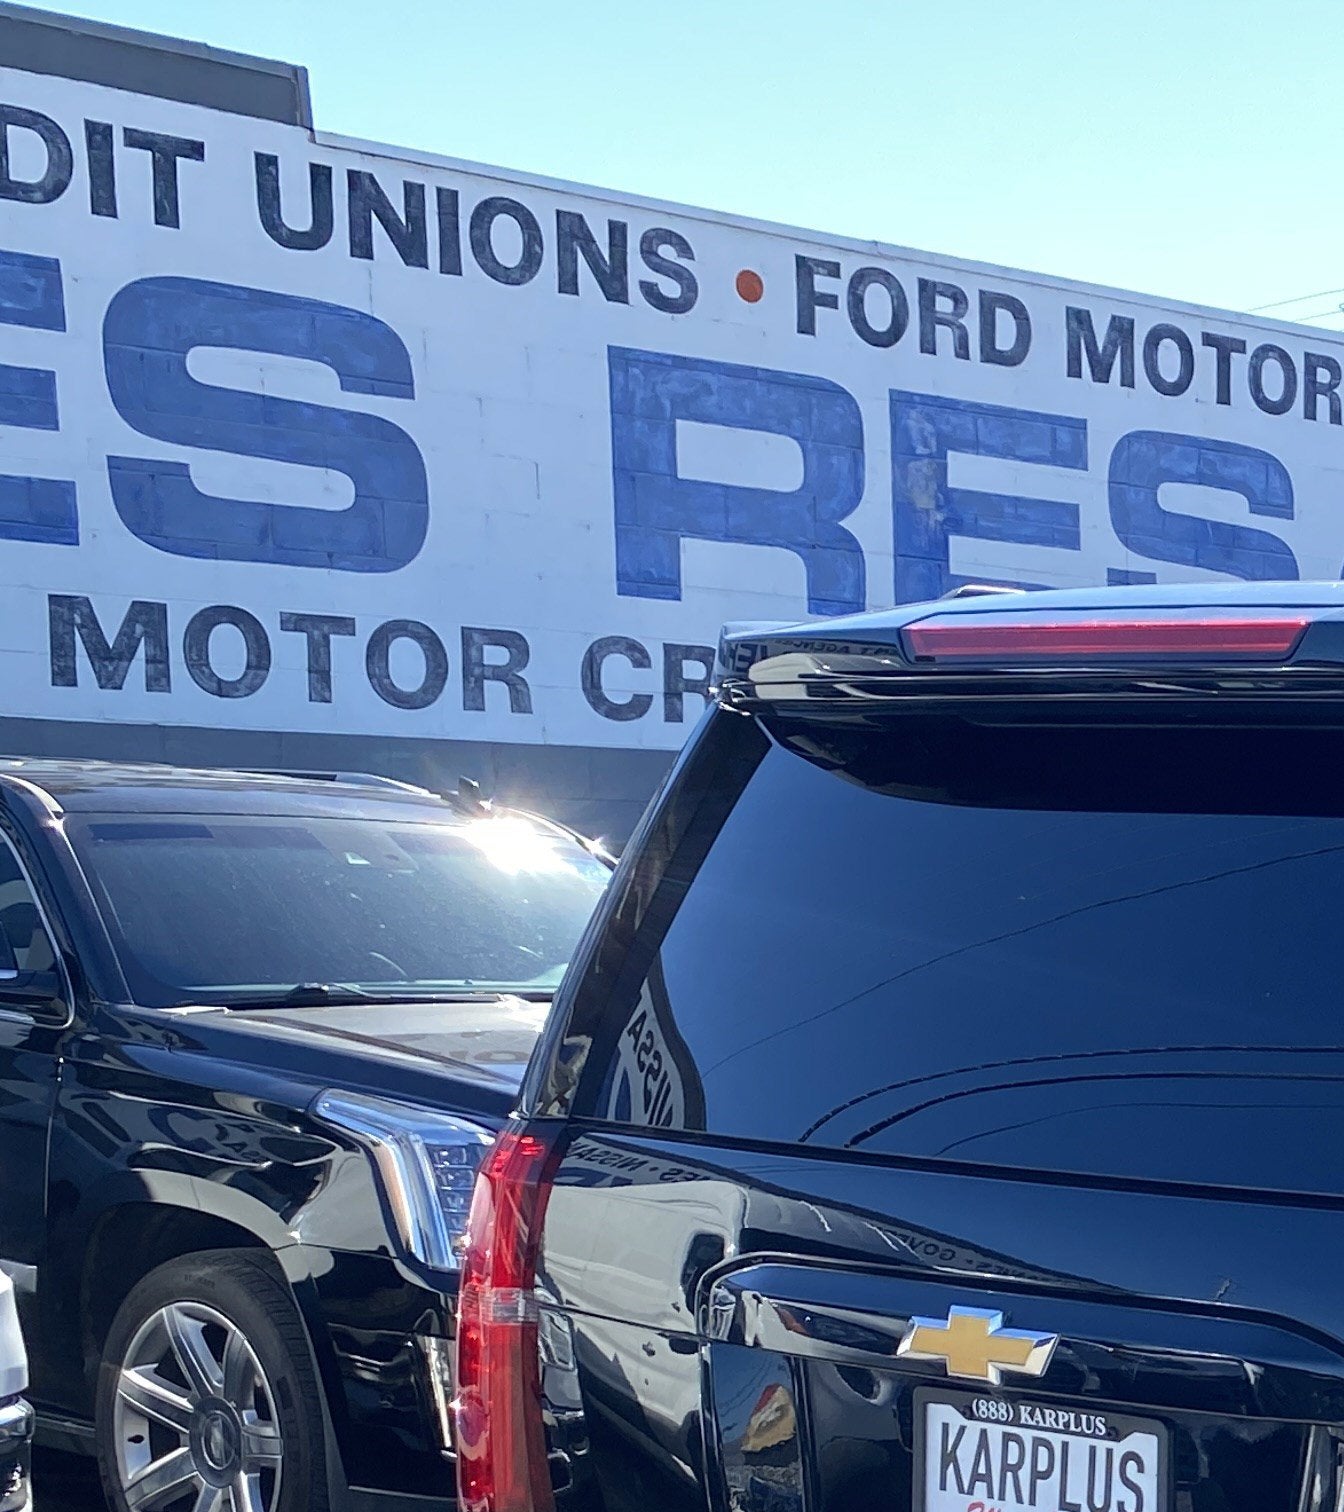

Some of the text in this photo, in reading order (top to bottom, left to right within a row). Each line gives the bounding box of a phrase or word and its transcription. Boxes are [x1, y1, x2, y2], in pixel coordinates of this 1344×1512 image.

[253, 152, 697, 314] UNIONS
[795, 254, 1031, 367] FORD
[1066, 305, 1342, 424] MOTOR
[48, 593, 532, 714] MOTOR
[972, 1399, 1107, 1436] (888) KARPLUS
